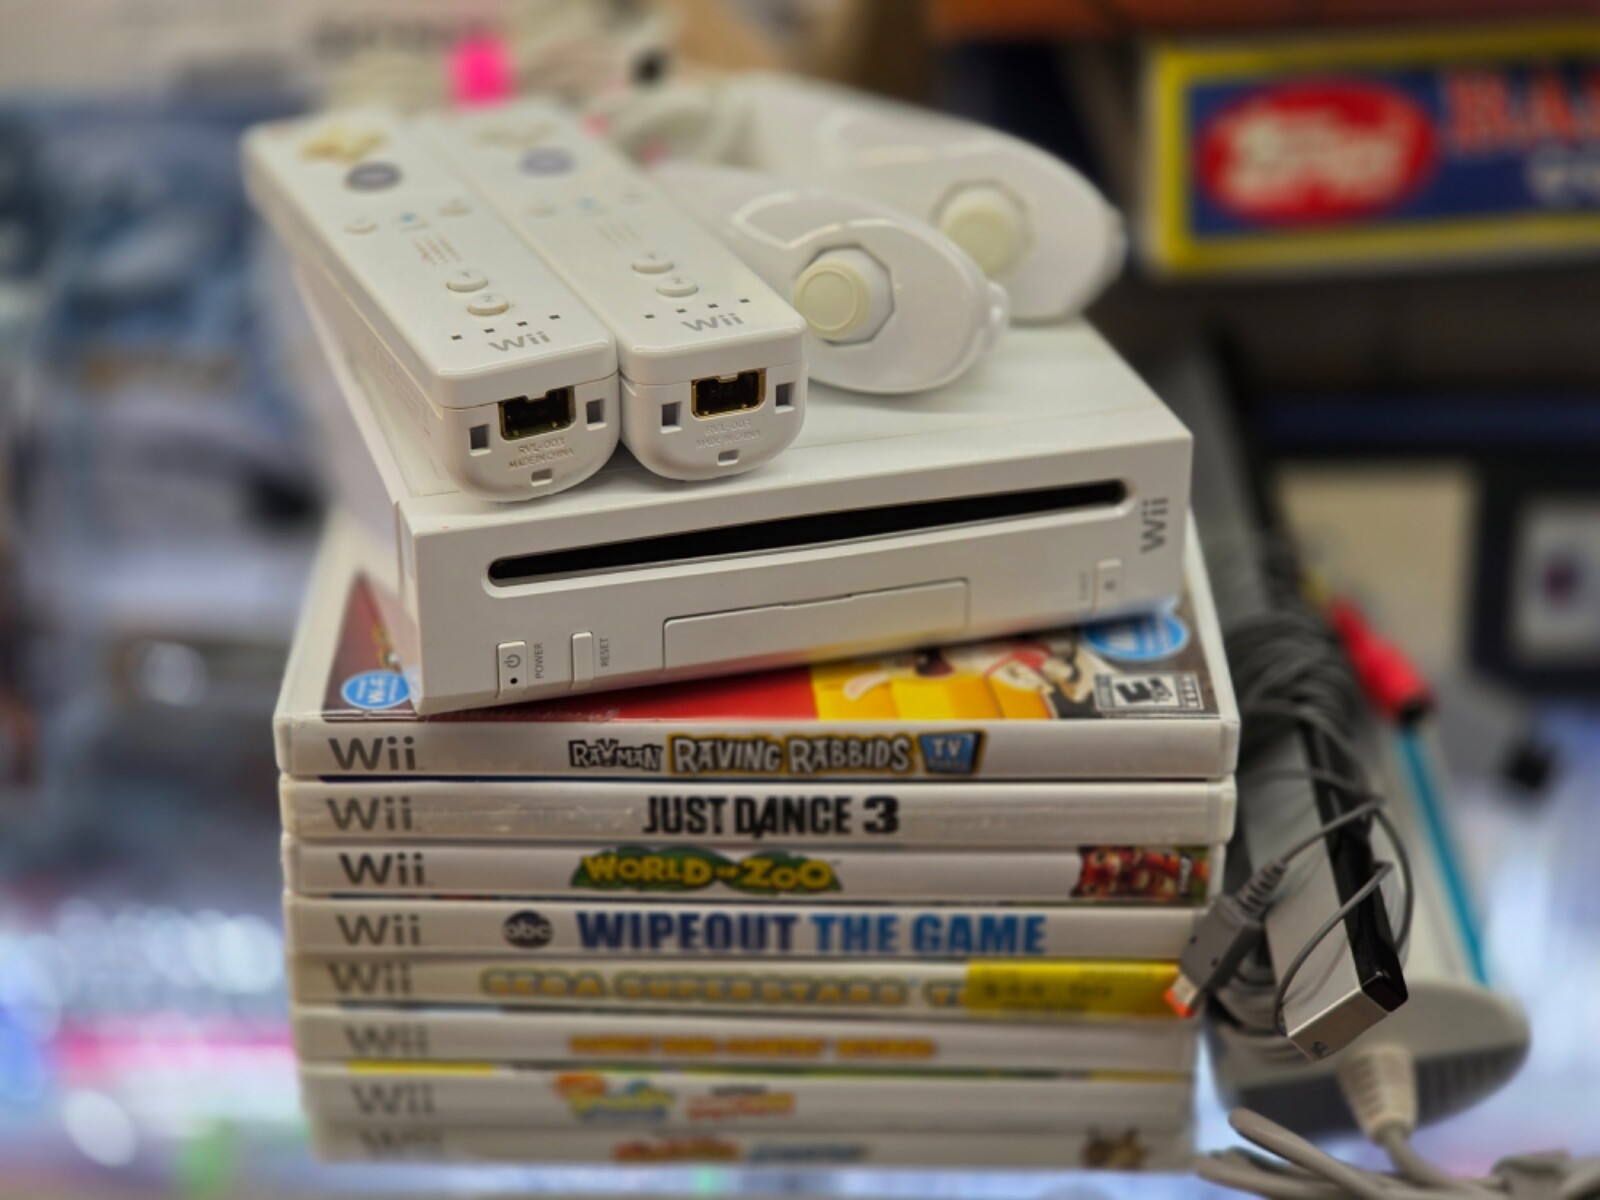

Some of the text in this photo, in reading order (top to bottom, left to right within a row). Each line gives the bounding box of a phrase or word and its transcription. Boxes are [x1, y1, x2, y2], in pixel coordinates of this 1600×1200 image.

[681, 312, 744, 332] Wii
[488, 330, 551, 352] Wii
[1141, 497, 1169, 553] Wii
[535, 642, 544, 680] POWER
[600, 637, 610, 668] RESET
[328, 733, 961, 774] Wii RAYMAN RAVING RABBIDS TV
[326, 796, 899, 838] Wii JUST DANCE 3
[339, 852, 425, 886] Wii
[582, 855, 713, 887] WORLD
[741, 858, 834, 889] ZOO
[335, 911, 1047, 955] Wii abc WIPEOUT THE GAME
[328, 961, 412, 995] Wii
[344, 1023, 430, 1055] Wii
[351, 1083, 436, 1114] Wii
